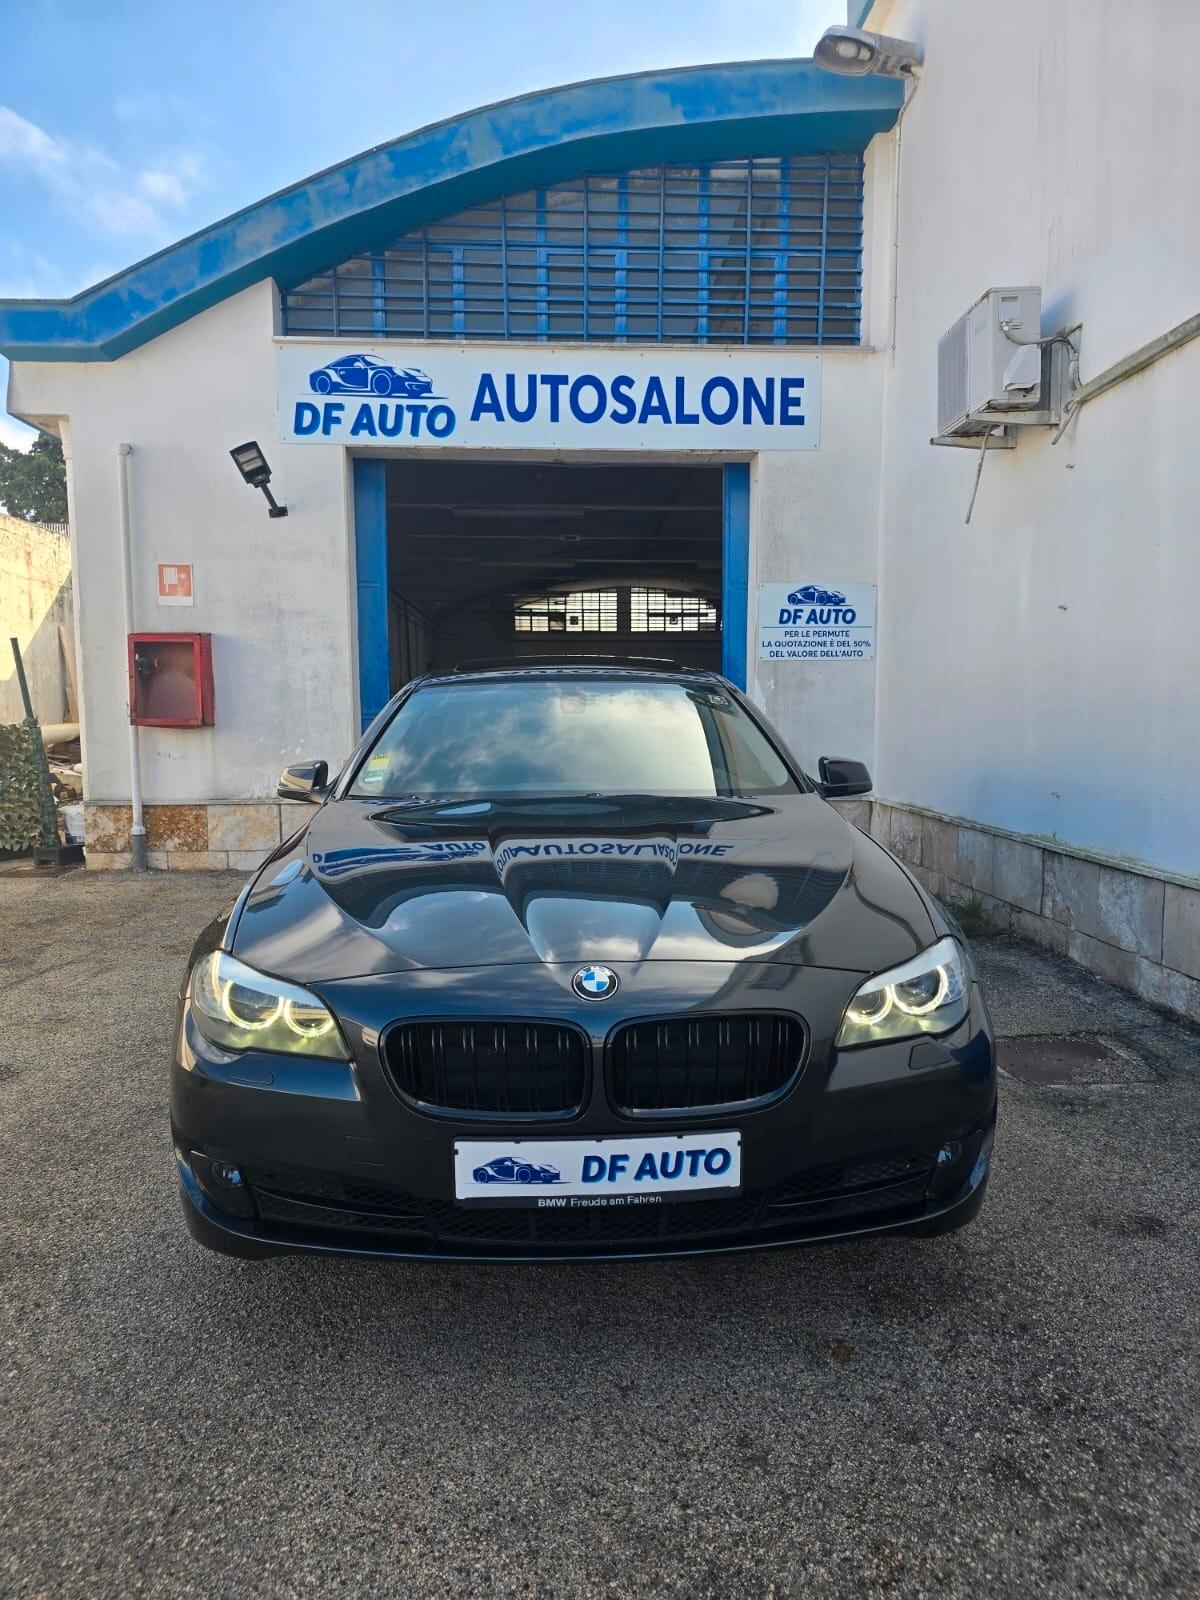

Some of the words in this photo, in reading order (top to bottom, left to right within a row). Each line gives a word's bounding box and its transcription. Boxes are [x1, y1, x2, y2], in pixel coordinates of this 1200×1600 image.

[470, 372, 805, 426] AUTOSALONE
[293, 402, 345, 436] DF
[350, 403, 456, 438] AUTO
[779, 608, 804, 625] DF
[806, 608, 857, 625] AUTO
[784, 630, 799, 638] PER
[801, 630, 811, 638] LE
[812, 630, 850, 638] PERMUTE
[775, 640, 828, 648] QUOTAZIONE
[836, 640, 851, 648] DEL
[853, 640, 871, 648] 50%
[769, 650, 785, 658] DEL
[787, 650, 818, 658] VALORE
[820, 650, 864, 658] DELL'AUTO
[581, 1154, 630, 1183] DF
[634, 1147, 732, 1181] AUTO
[538, 1198, 567, 1207] BMW
[570, 1198, 607, 1207] Freude
[609, 1197, 625, 1206] am
[627, 1195, 662, 1204] Fahren
